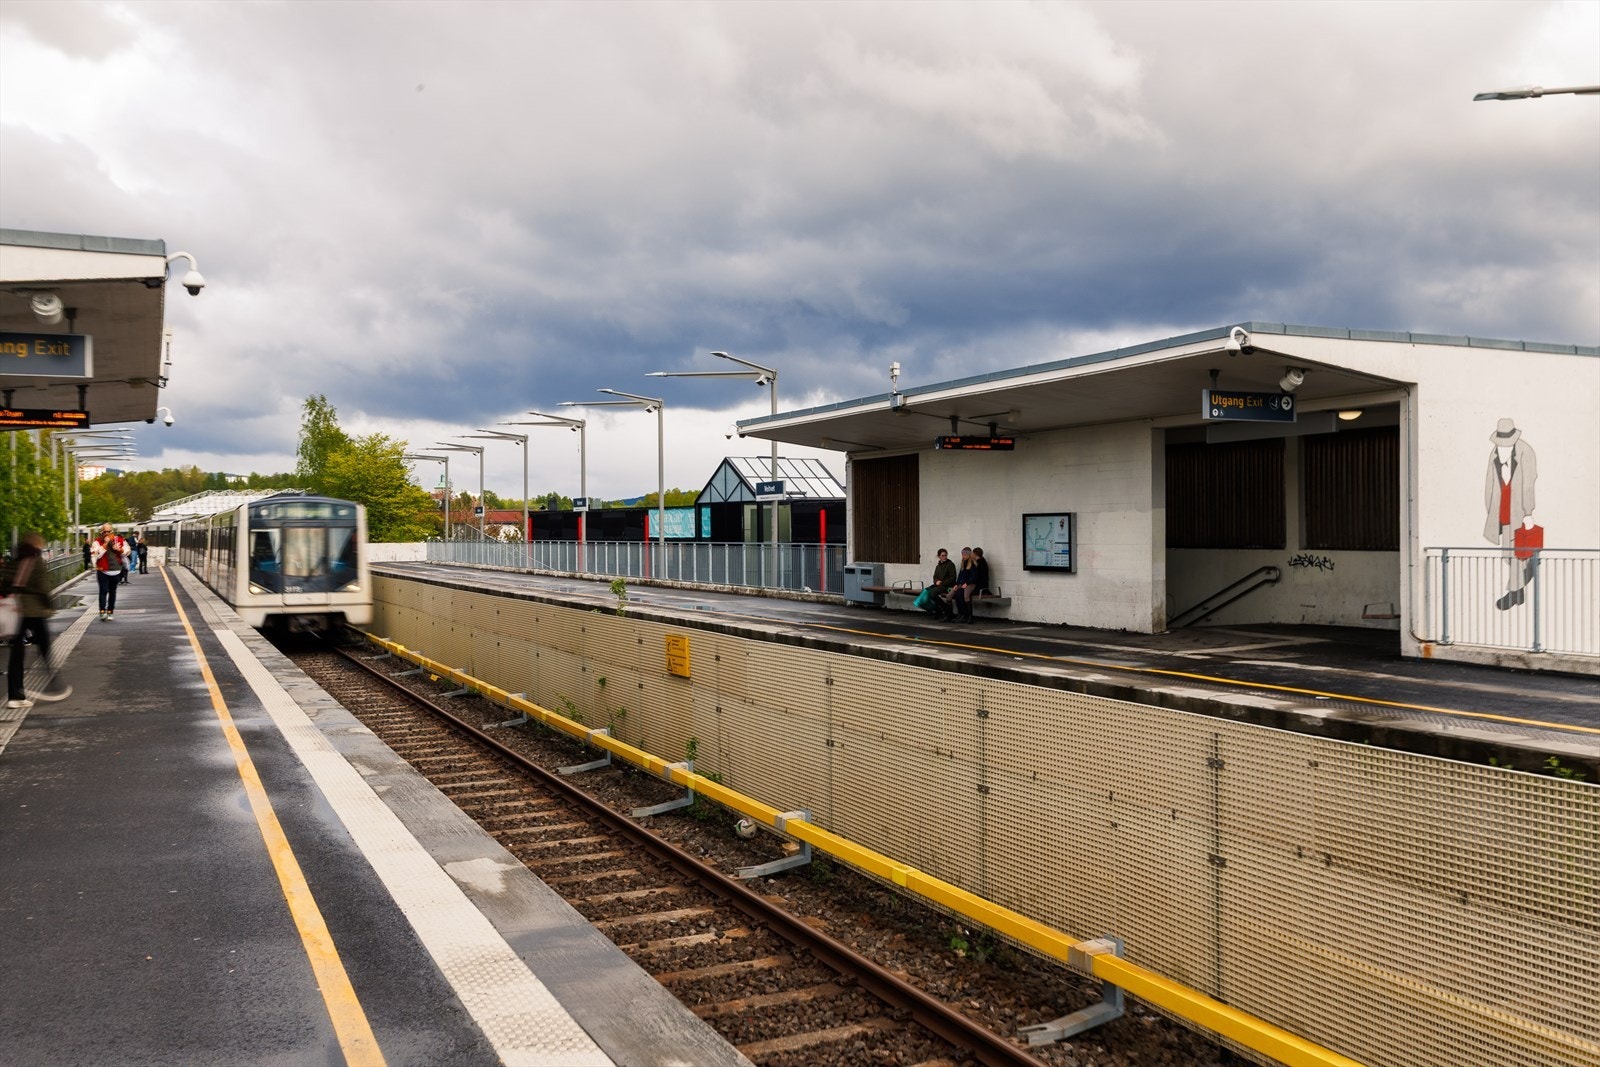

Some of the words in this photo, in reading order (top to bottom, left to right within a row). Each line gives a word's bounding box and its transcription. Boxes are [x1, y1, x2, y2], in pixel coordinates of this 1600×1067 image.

[0, 342, 28, 358] ng
[34, 340, 71, 356] Exit
[1211, 394, 1244, 408] Utgang
[1246, 396, 1263, 407] Exit
